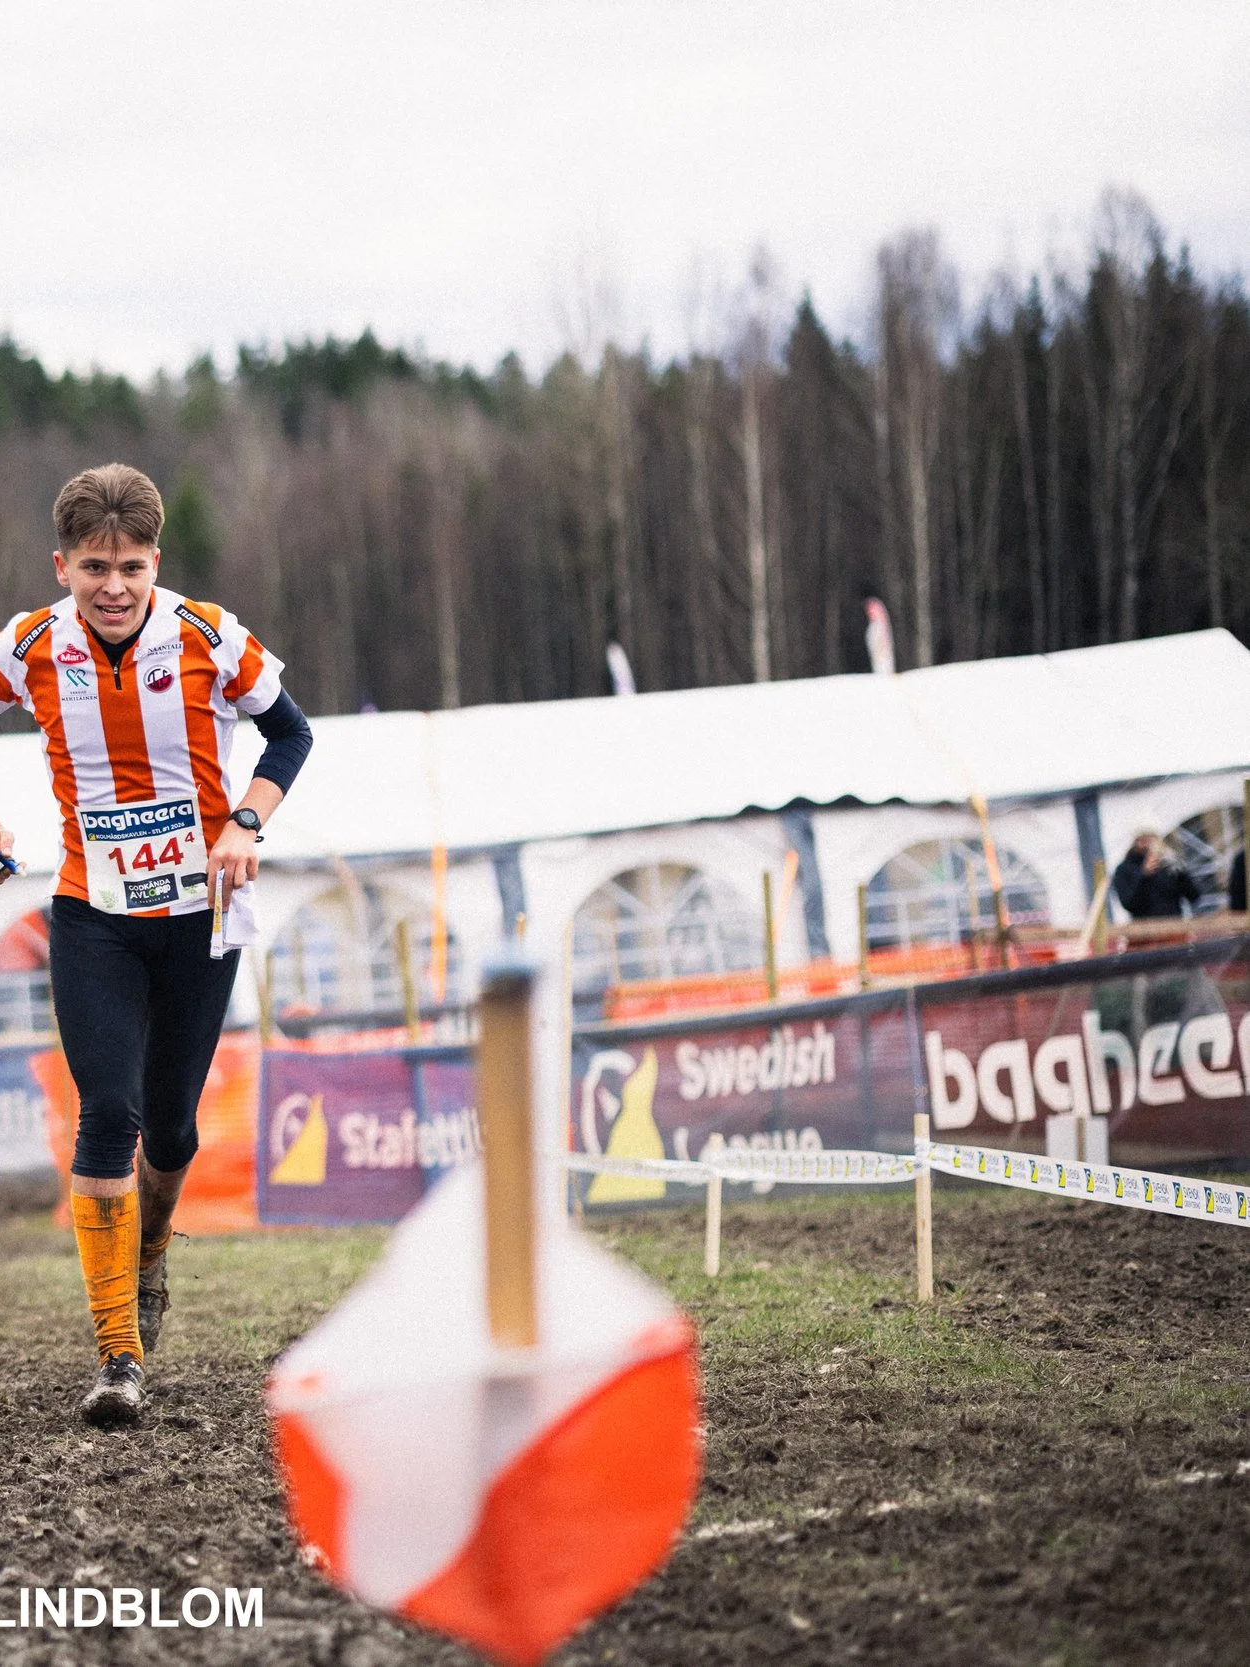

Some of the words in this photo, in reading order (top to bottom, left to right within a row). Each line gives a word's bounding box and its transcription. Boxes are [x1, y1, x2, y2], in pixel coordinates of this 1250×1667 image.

[177, 607, 219, 645] noname
[82, 803, 193, 832] bagheera
[108, 837, 184, 875] 144
[184, 831, 195, 843] 4
[675, 1021, 836, 1100] Swedish
